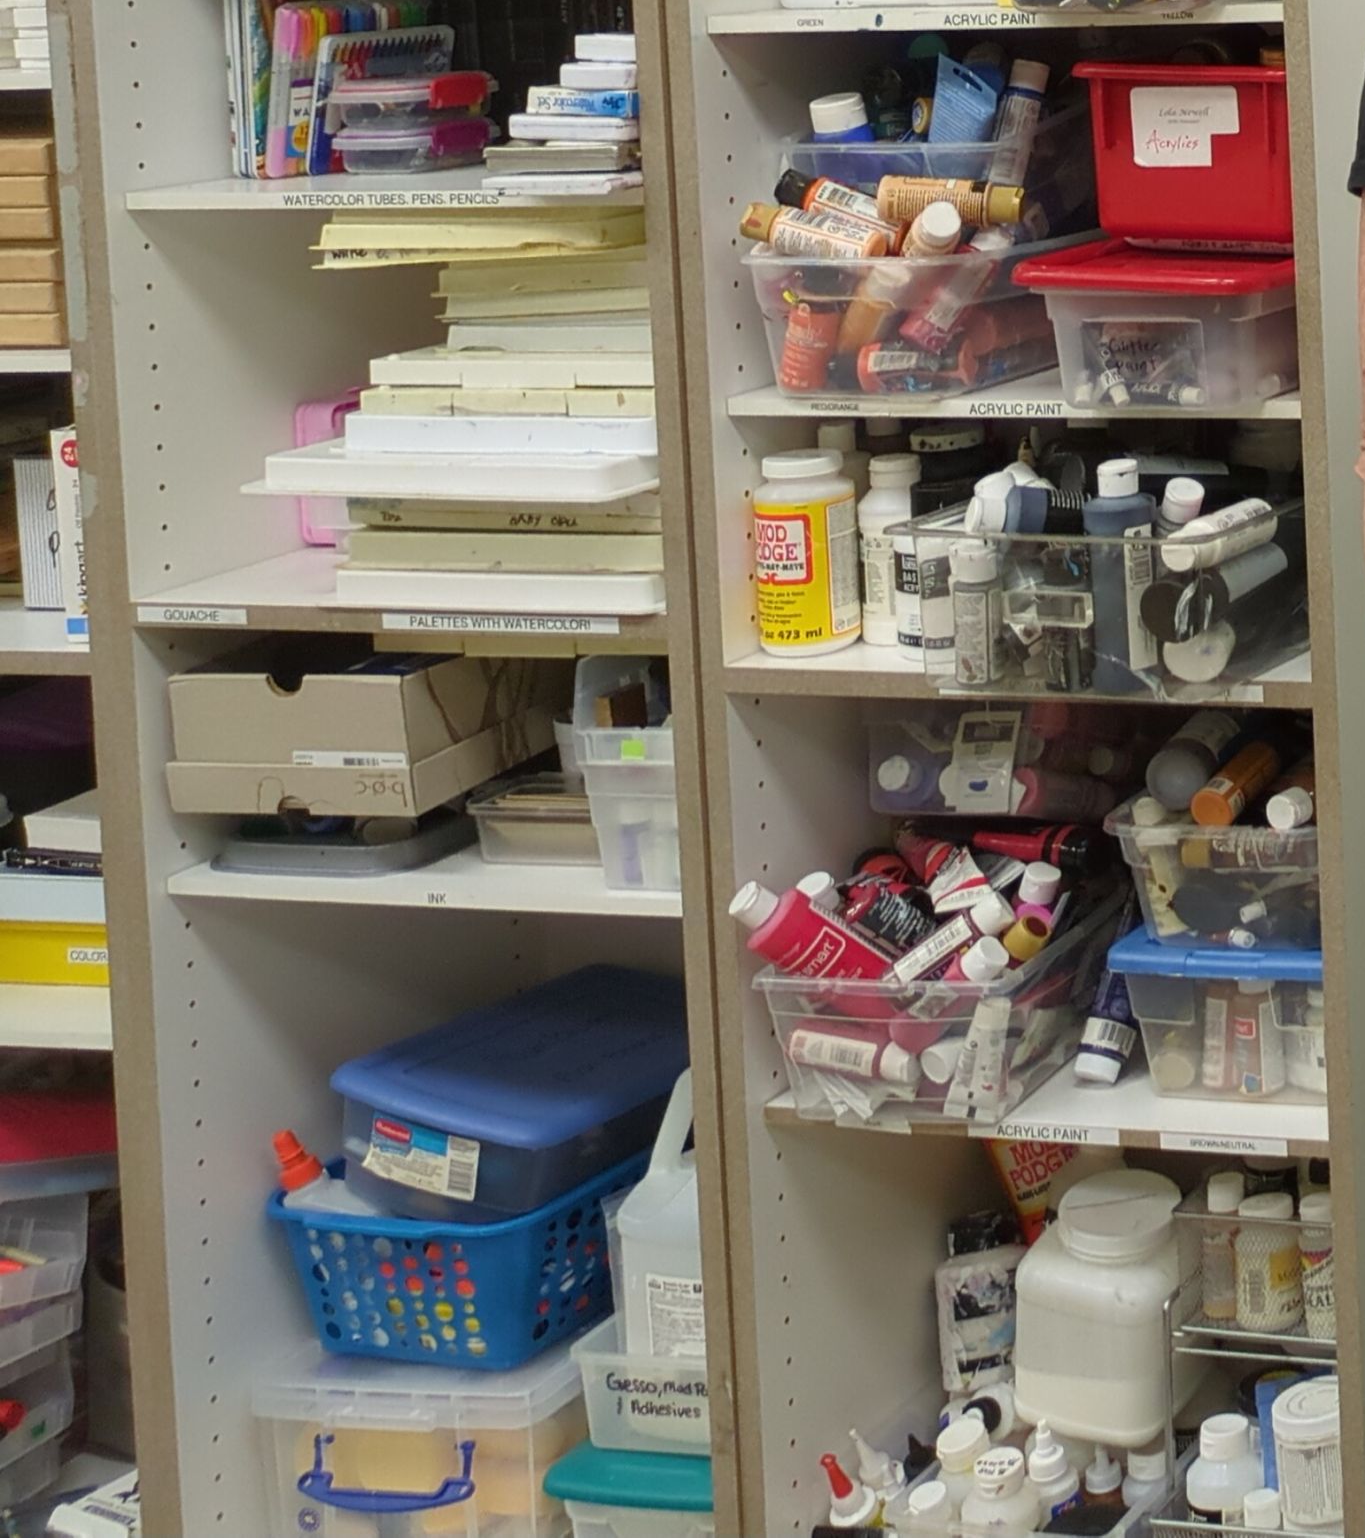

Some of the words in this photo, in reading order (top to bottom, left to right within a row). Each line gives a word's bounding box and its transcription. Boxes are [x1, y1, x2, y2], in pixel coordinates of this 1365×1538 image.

[944, 14, 998, 27] ACRYLIC
[1001, 12, 1038, 25] PAINT
[1145, 128, 1201, 154] Acrylics
[283, 193, 365, 206] WATERCOLOR
[449, 192, 500, 205] PENCILS
[969, 403, 1024, 416] ACRYLIC
[1026, 403, 1063, 416] PAINT
[63, 445, 76, 462] 24
[756, 523, 788, 543] MOD
[757, 542, 799, 562] ODGE
[902, 572, 918, 584] BAS
[163, 609, 220, 622] GOUACHE
[409, 615, 469, 630] PALETTES
[471, 617, 500, 630] WITH
[503, 618, 591, 631] WATERCOLOR!
[777, 629, 801, 640] 473
[806, 627, 823, 638] ml
[427, 893, 447, 905] INK
[996, 1124, 1050, 1140] ACRYLIC
[1053, 1127, 1090, 1142] PAINT
[630, 1398, 701, 1419] Adhesives
